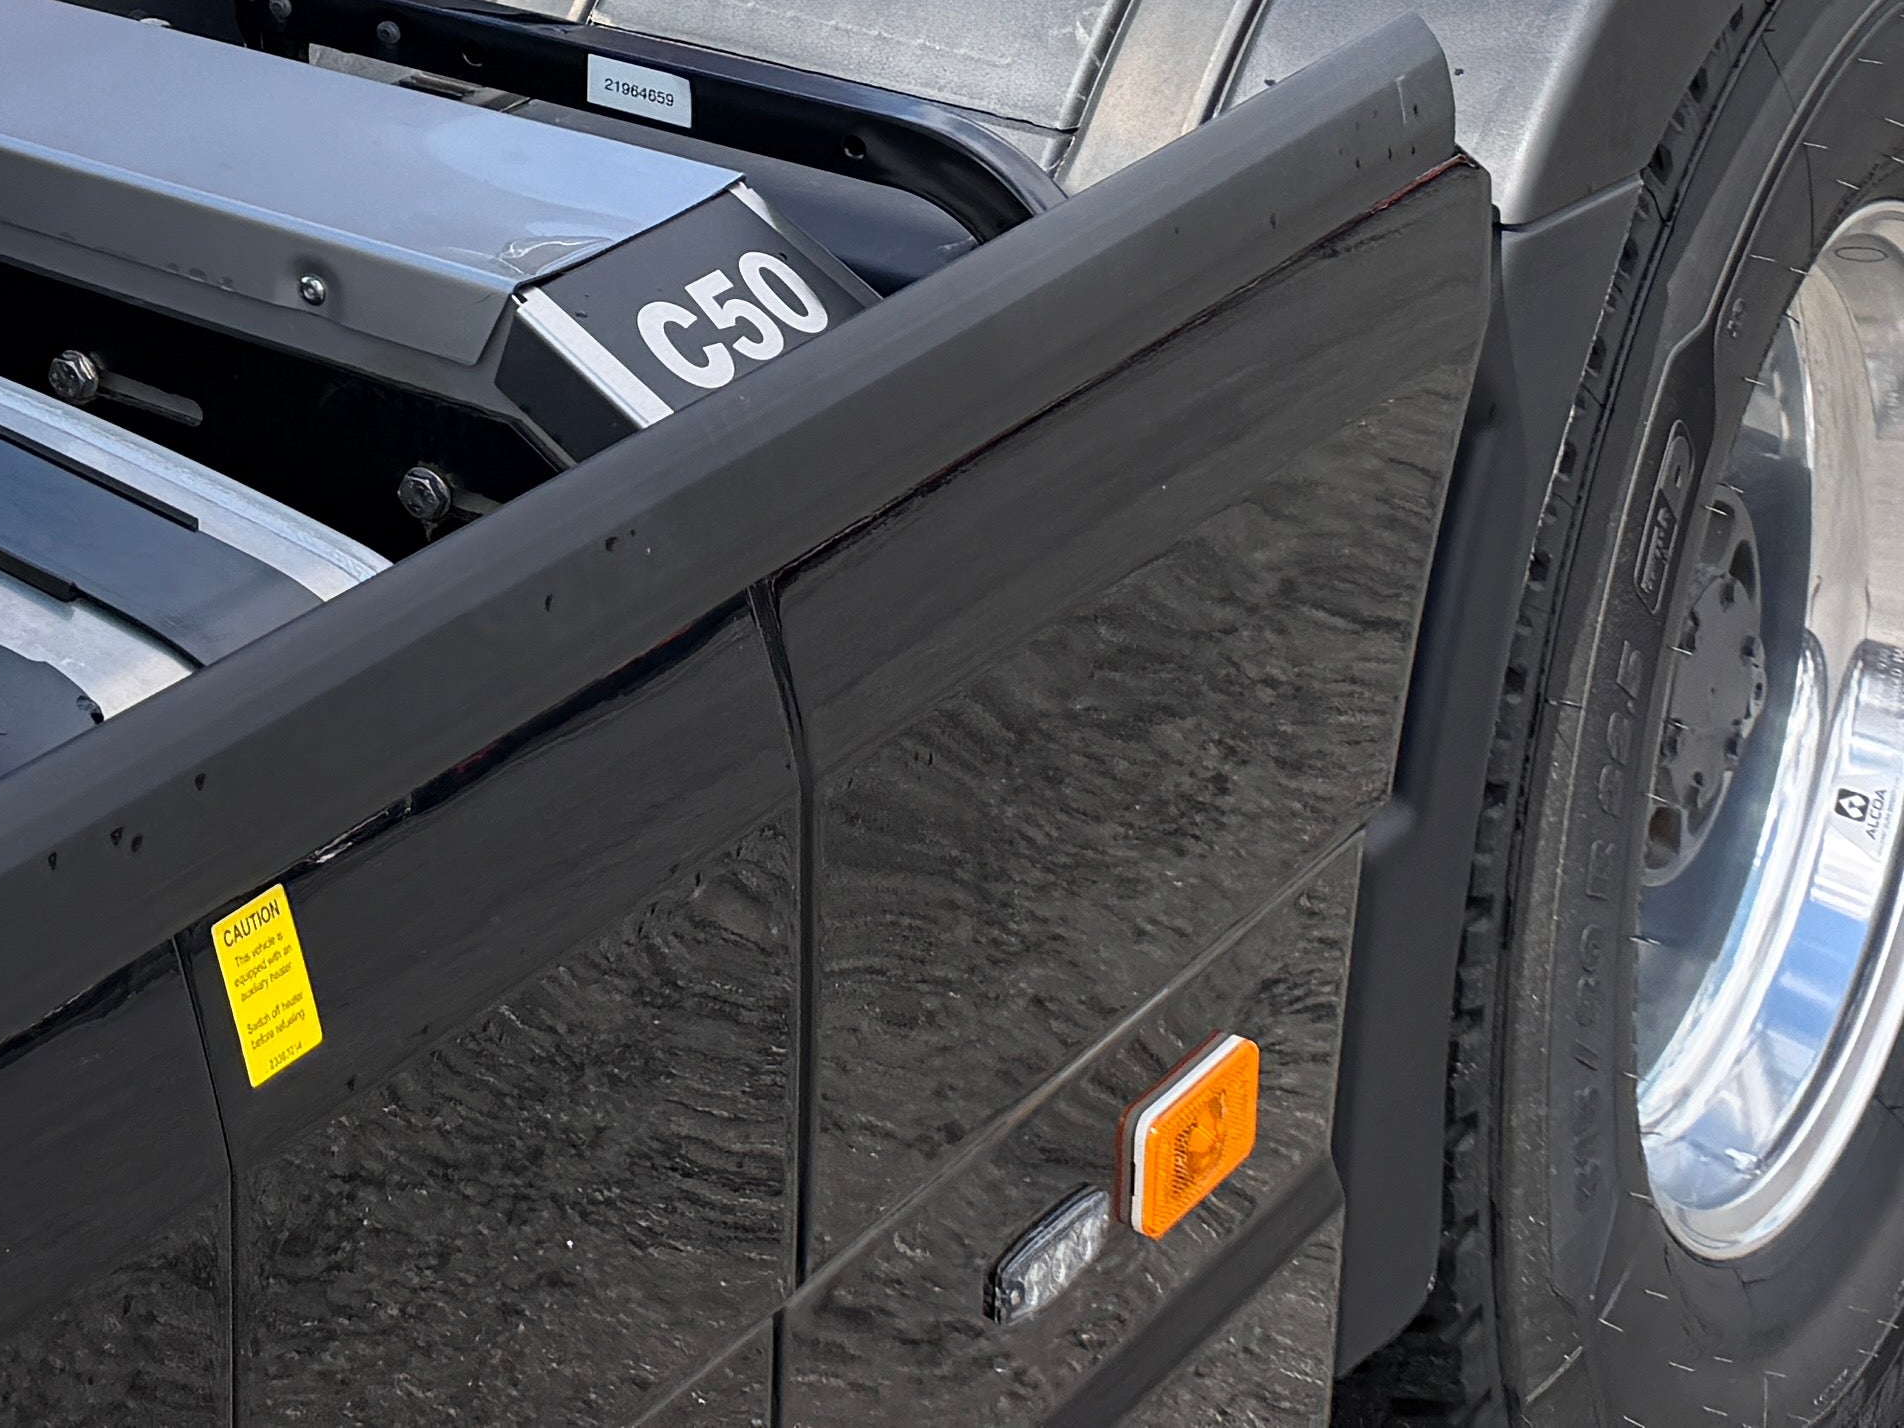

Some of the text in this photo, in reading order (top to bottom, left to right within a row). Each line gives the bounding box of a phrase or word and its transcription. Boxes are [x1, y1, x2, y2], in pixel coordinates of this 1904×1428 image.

[603, 77, 675, 108] 21964659
[637, 251, 829, 389] C50
[1865, 789, 1887, 840] ALCOA
[223, 899, 280, 947] CAUTION
